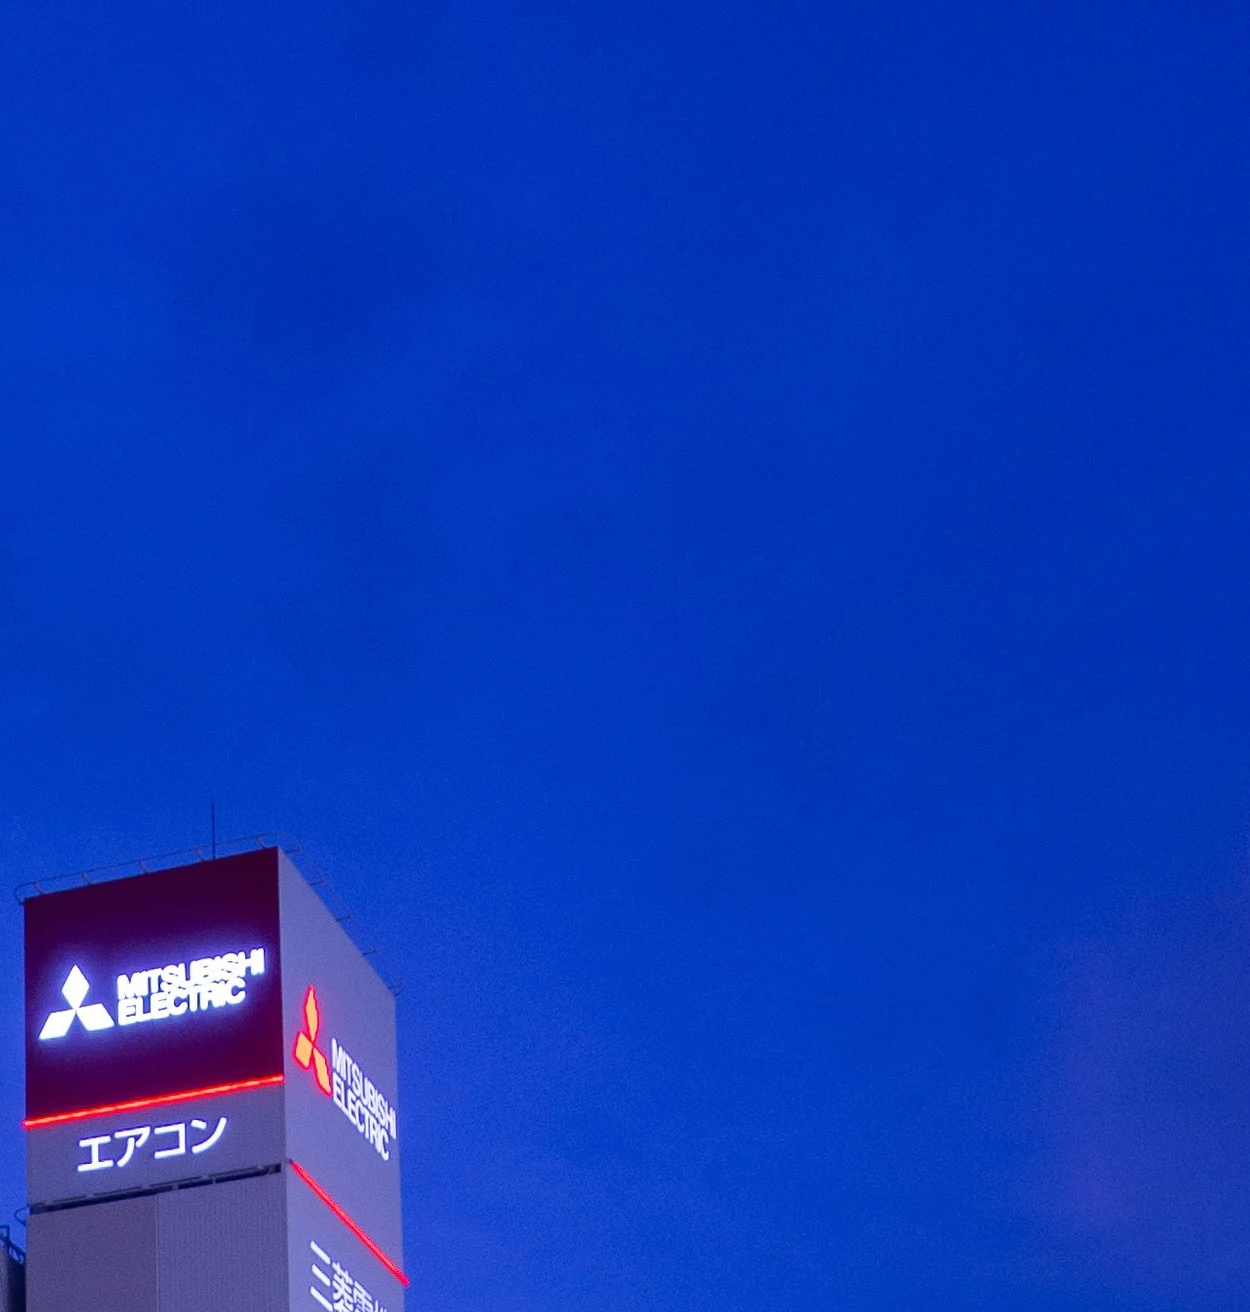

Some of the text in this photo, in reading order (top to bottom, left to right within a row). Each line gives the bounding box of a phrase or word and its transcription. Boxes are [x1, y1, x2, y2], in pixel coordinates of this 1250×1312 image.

[116, 948, 265, 1000] MITSUBISHI
[118, 977, 246, 1026] ELECTRIC
[331, 1037, 397, 1140] MITSUBISHI
[333, 1071, 390, 1161] ELECTRIC
[77, 1116, 228, 1173] エアコン
